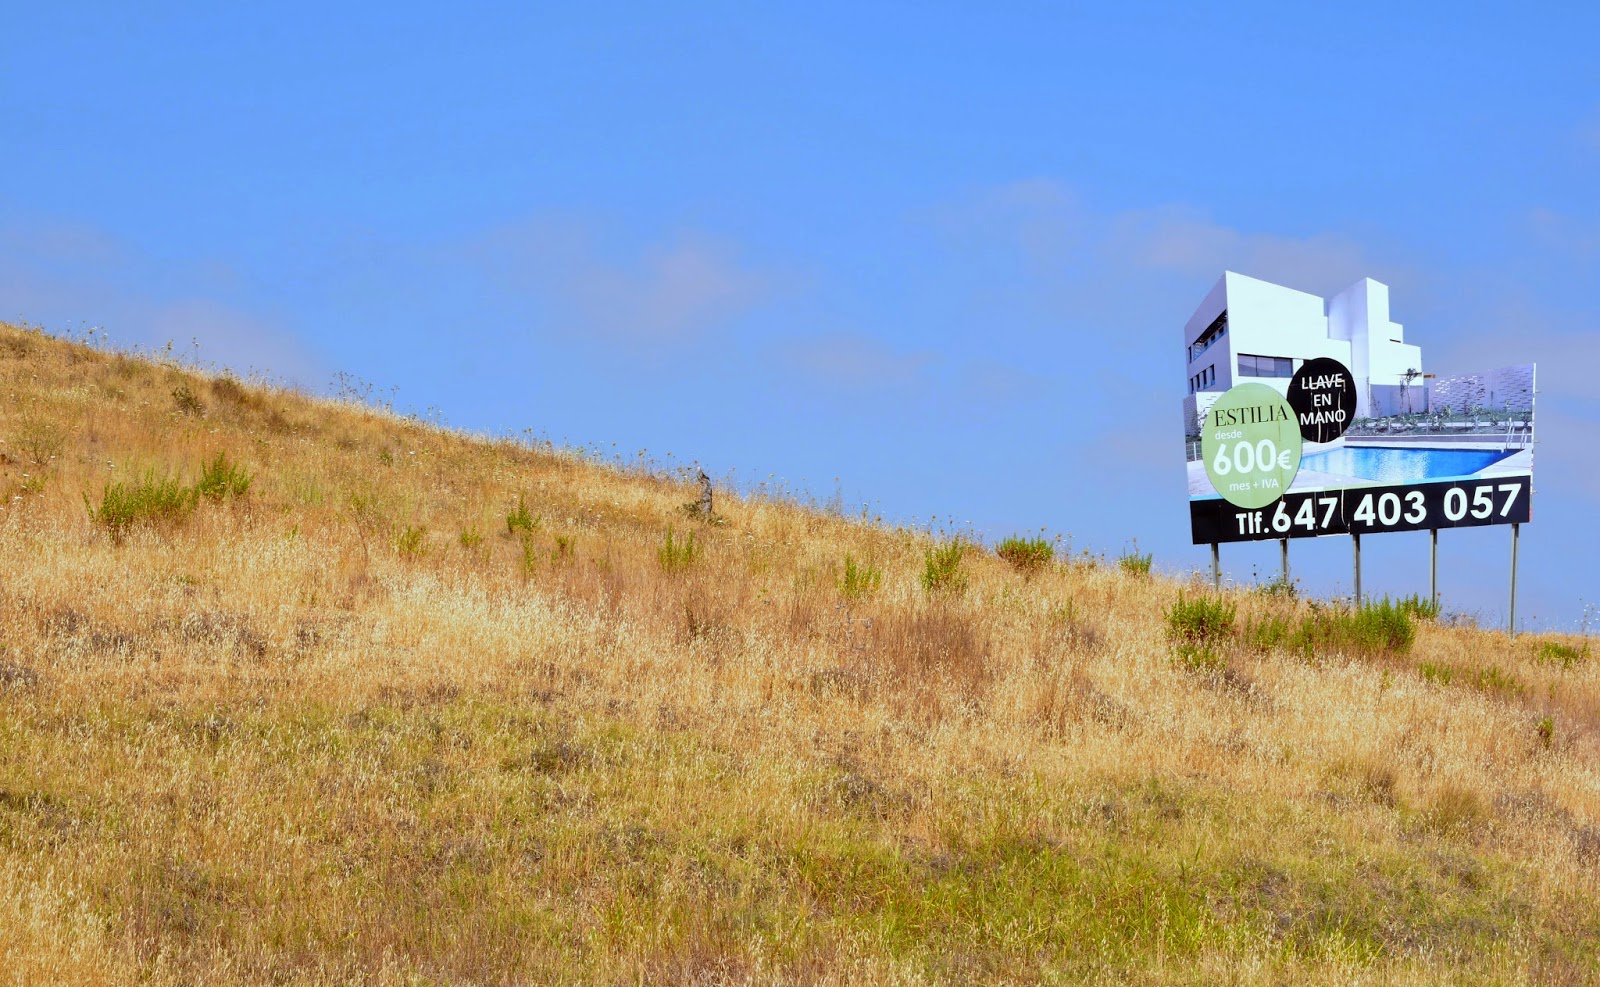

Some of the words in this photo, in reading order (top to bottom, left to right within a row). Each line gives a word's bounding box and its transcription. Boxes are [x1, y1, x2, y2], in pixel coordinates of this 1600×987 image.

[1301, 373, 1343, 390] LLAVE
[1313, 393, 1332, 407] EN
[1214, 404, 1289, 427] ESTILIA
[1300, 409, 1346, 426] MANO
[1214, 430, 1242, 440] desde
[1213, 438, 1292, 476] 600€
[1229, 481, 1250, 491] mes
[1262, 478, 1279, 489] IVA
[1353, 490, 1427, 527] 403
[1443, 483, 1522, 521] 057
